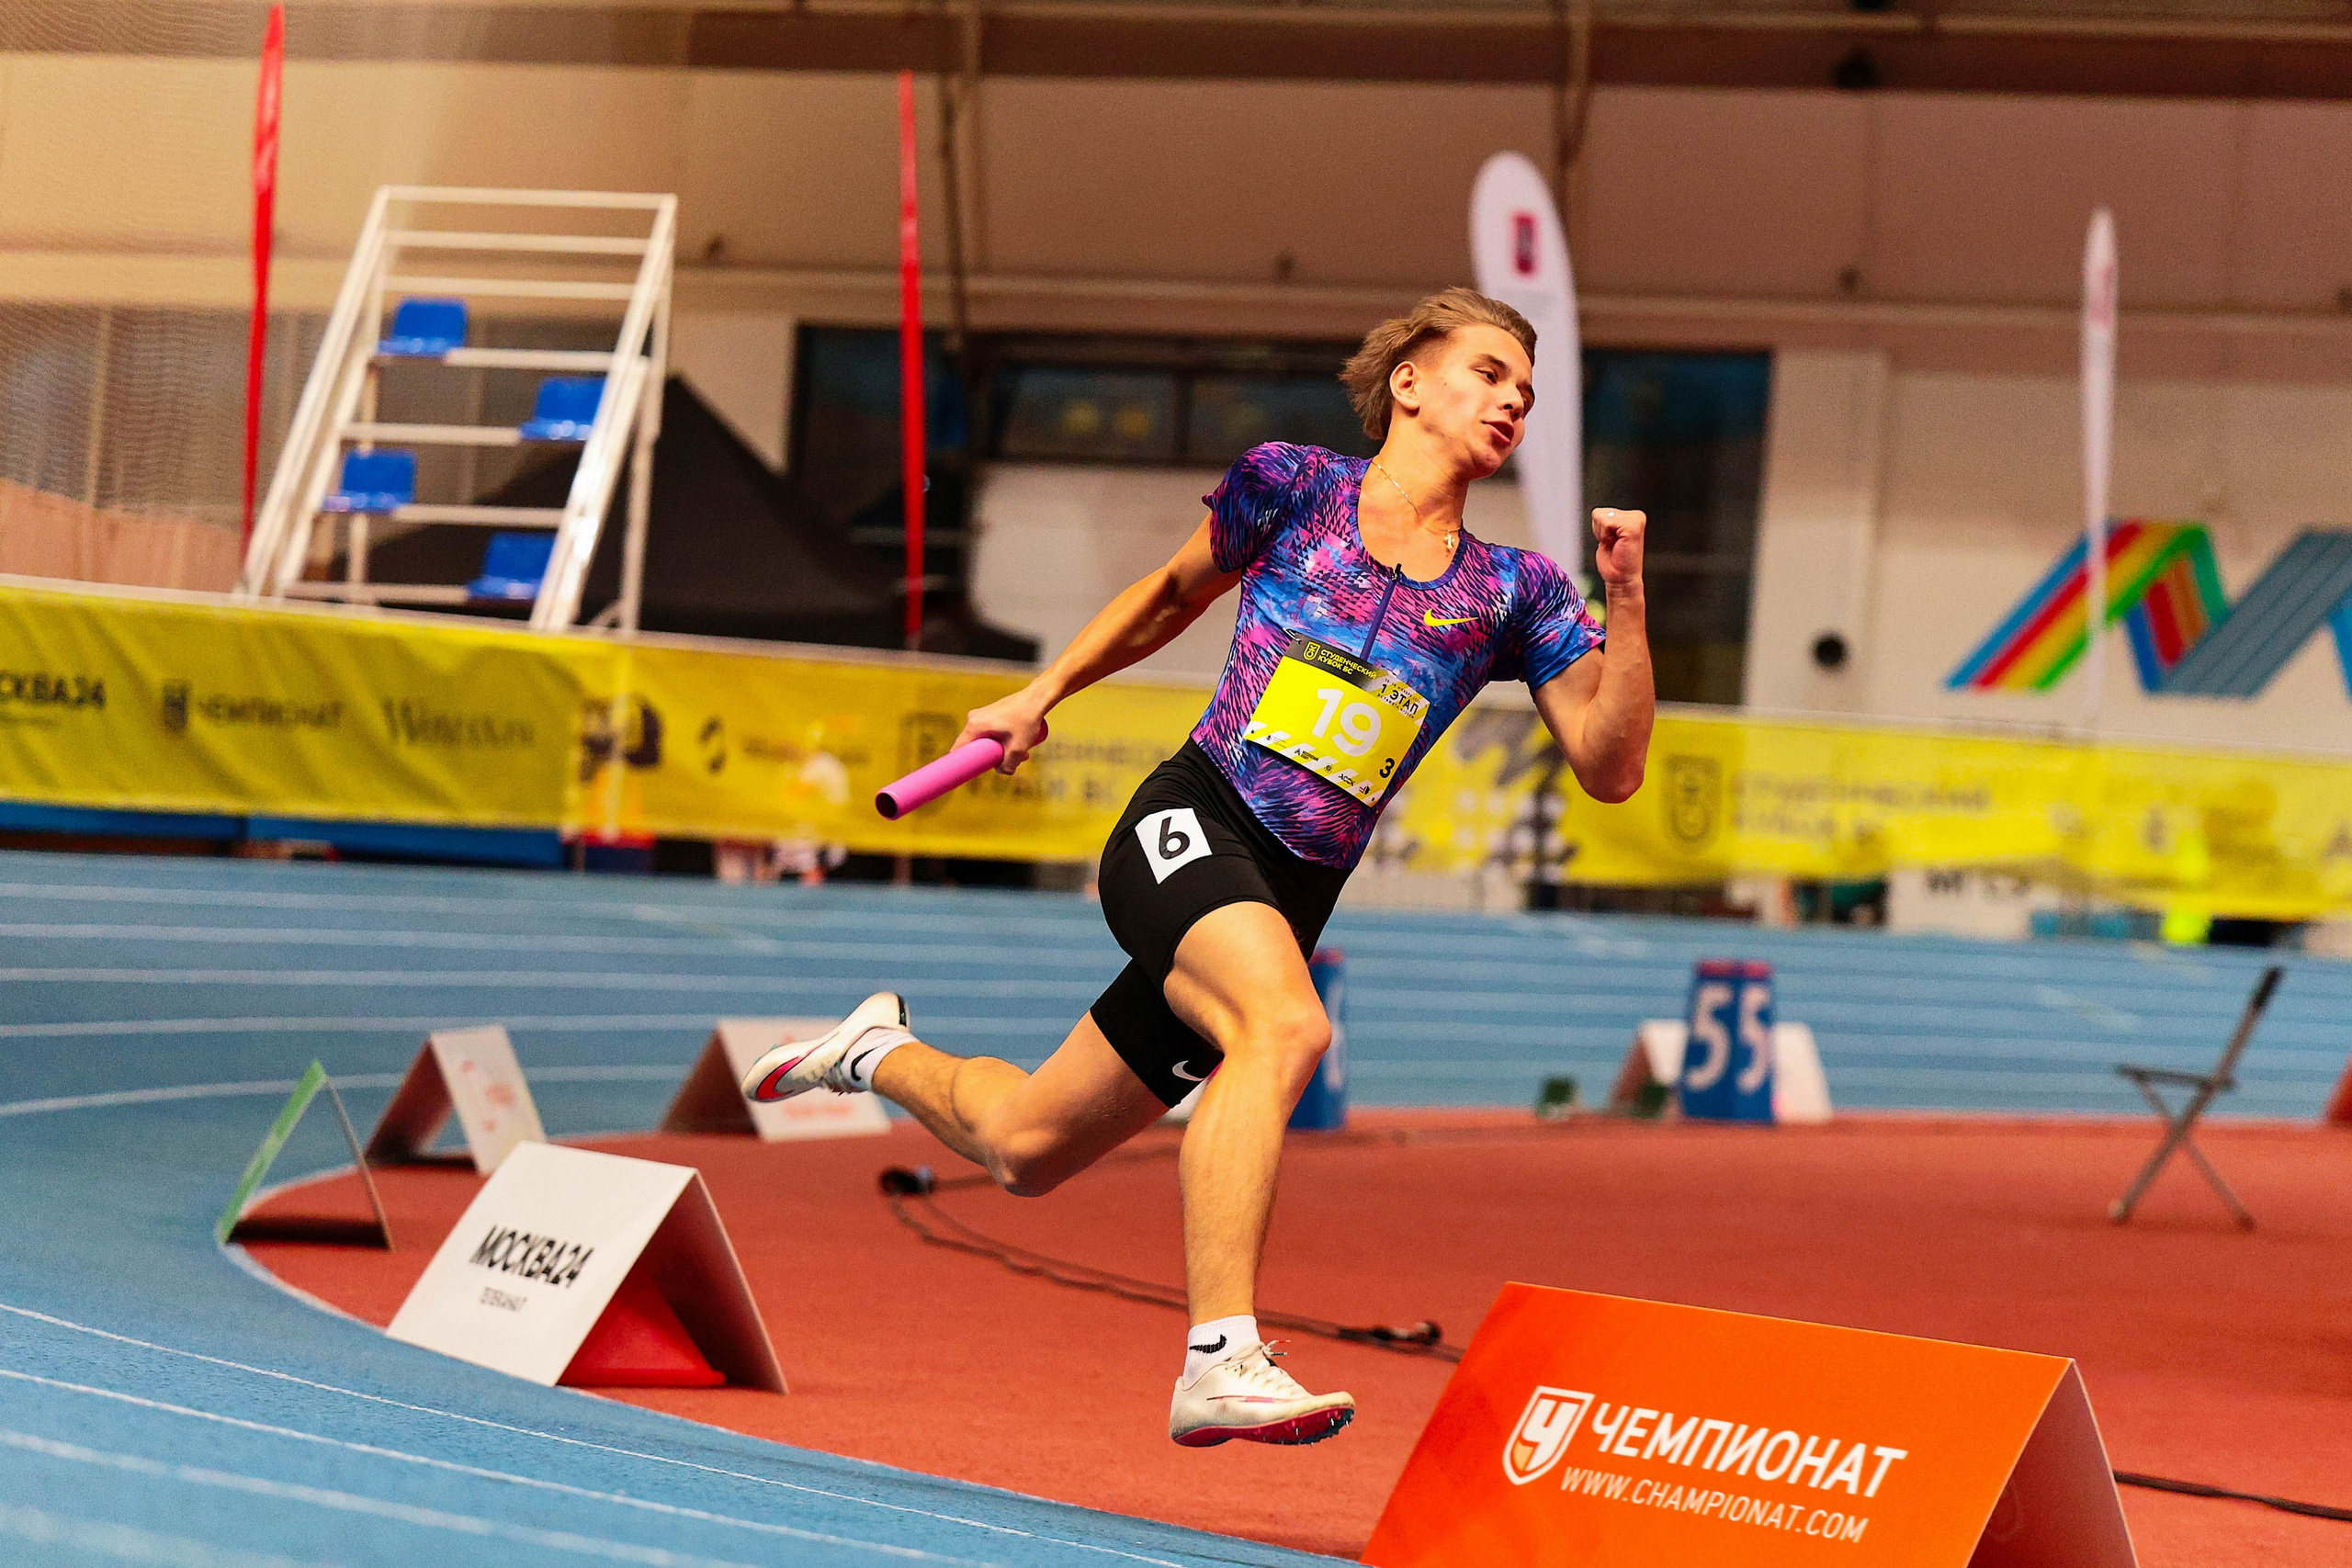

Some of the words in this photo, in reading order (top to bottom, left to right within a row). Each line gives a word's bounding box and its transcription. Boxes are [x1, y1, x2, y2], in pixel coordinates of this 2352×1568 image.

[1317, 655, 1343, 672] КУБОК
[1320, 649, 1377, 680] СТУДЕНЧЕСКИЙ
[1381, 683, 1387, 694] 1
[1389, 690, 1419, 715] ЭТАП
[1311, 688, 1382, 757] 19
[1379, 757, 1396, 779] 3
[1159, 816, 1191, 860] 6
[469, 1225, 594, 1289] МОСКВА24
[1592, 1402, 1908, 1498] ЧЕМПИОНАТ
[1560, 1466, 1870, 1544] WWW.CHAMPIONAT.COM
